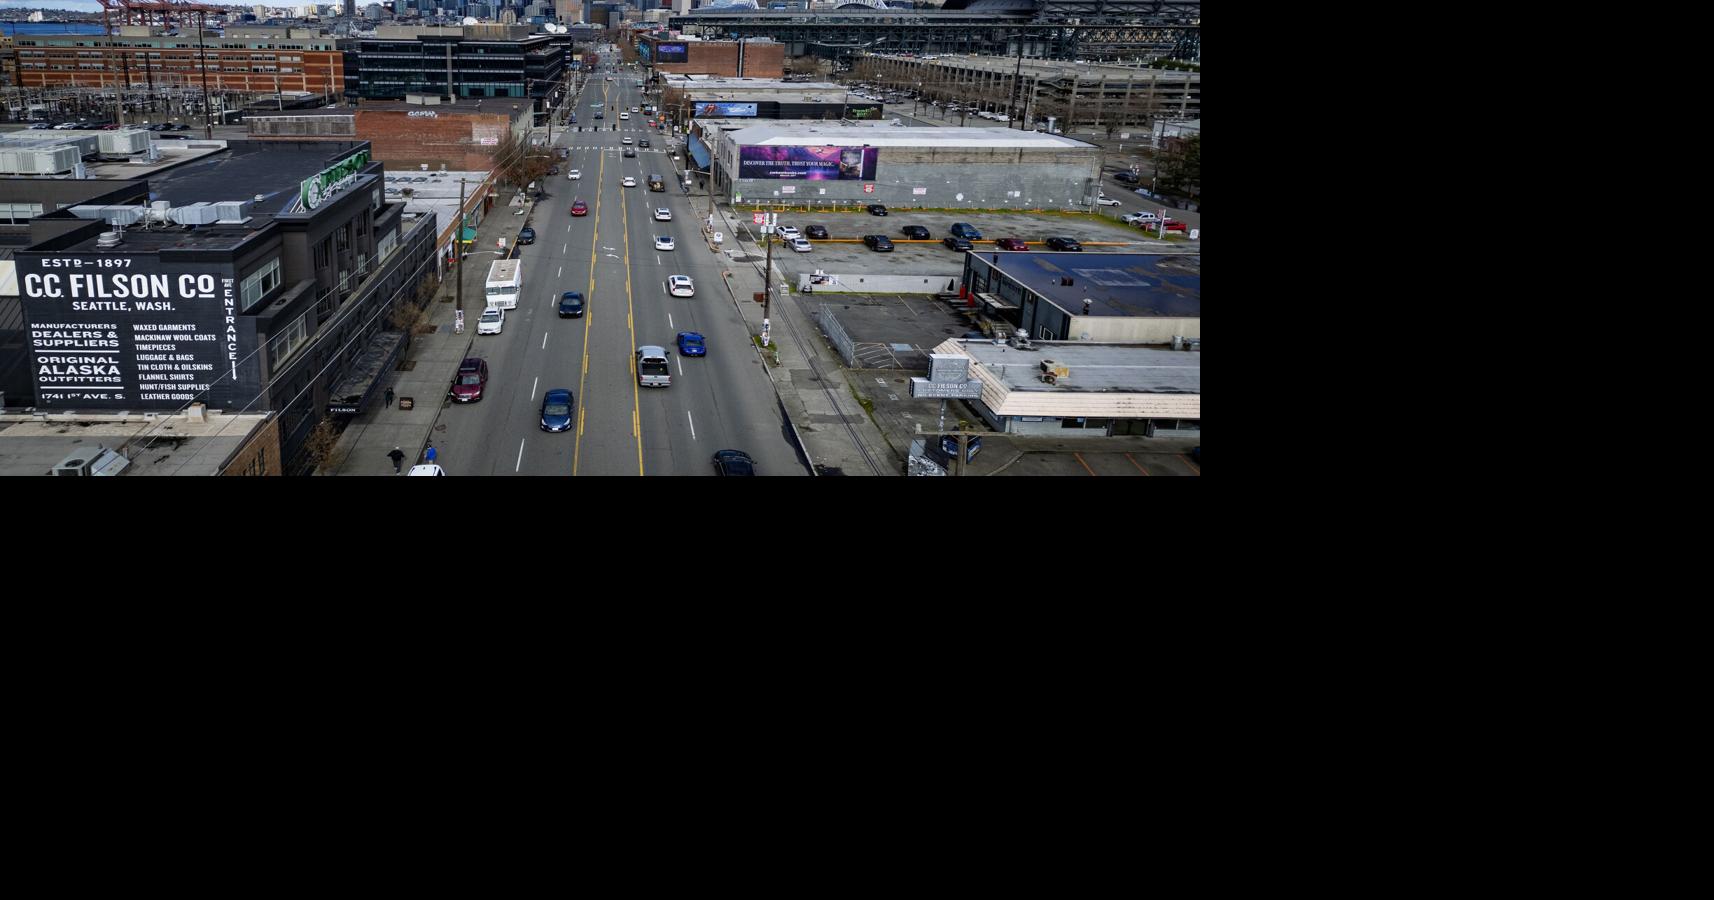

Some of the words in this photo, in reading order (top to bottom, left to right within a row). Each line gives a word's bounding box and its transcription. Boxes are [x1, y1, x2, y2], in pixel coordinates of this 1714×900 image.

[24, 273, 65, 298] C.C.
[69, 273, 170, 298] FILSON
[72, 301, 132, 312] SEATTLE,
[135, 301, 176, 311] WASH.
[106, 331, 118, 339] &
[33, 339, 119, 347] SUPPLIERS
[37, 356, 119, 364] ORIGINAL
[39, 365, 121, 375] ALASKA
